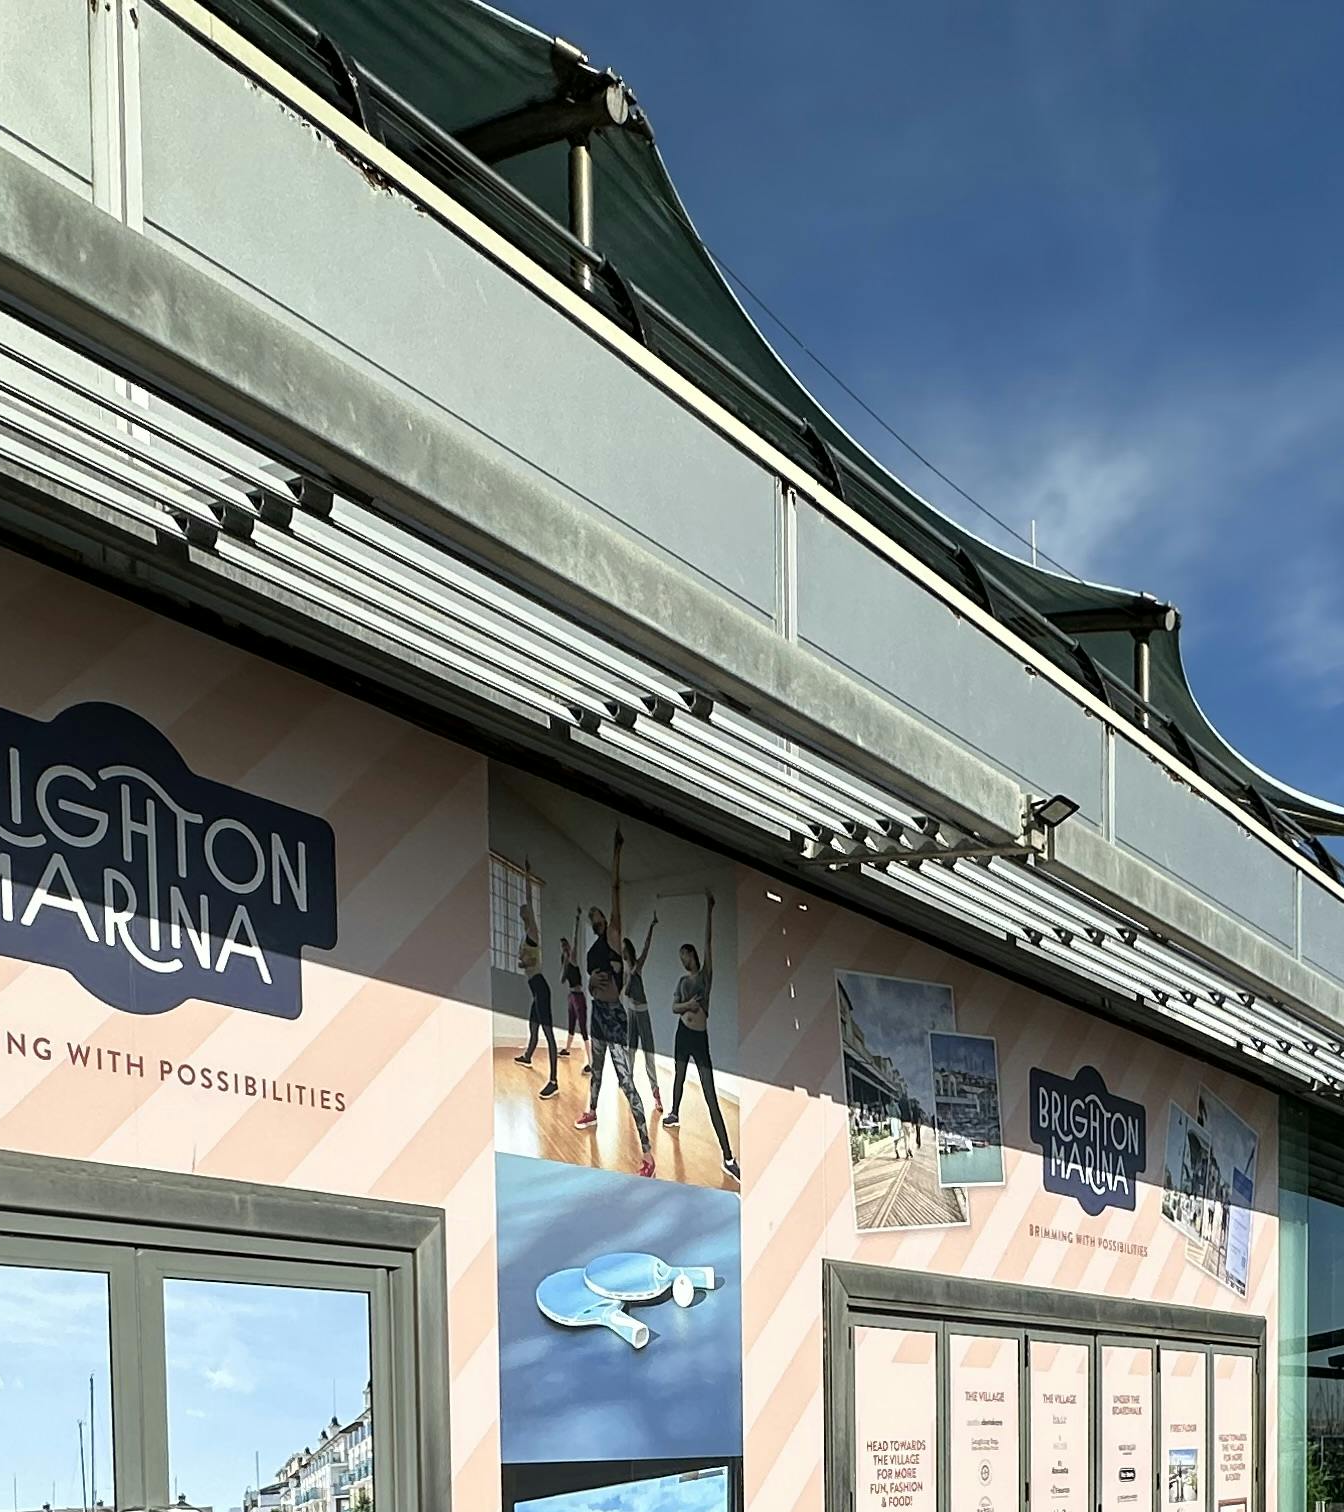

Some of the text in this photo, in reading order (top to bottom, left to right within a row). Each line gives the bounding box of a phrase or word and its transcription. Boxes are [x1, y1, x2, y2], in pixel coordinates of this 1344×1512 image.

[67, 1042, 144, 1077] WITH
[159, 1059, 347, 1112] POSSIBILITIES
[1038, 1086, 1141, 1156] BRIGHTON
[1050, 1135, 1130, 1196] MARINA
[1029, 1224, 1073, 1243] BRIMMING
[1076, 1233, 1096, 1247] WITH
[866, 1440, 926, 1452] HEAD TOWARDS
[873, 1454, 920, 1466] THE VILLAGE
[877, 1467, 917, 1480] FOR MORE
[890, 1481, 923, 1493] FASHION
